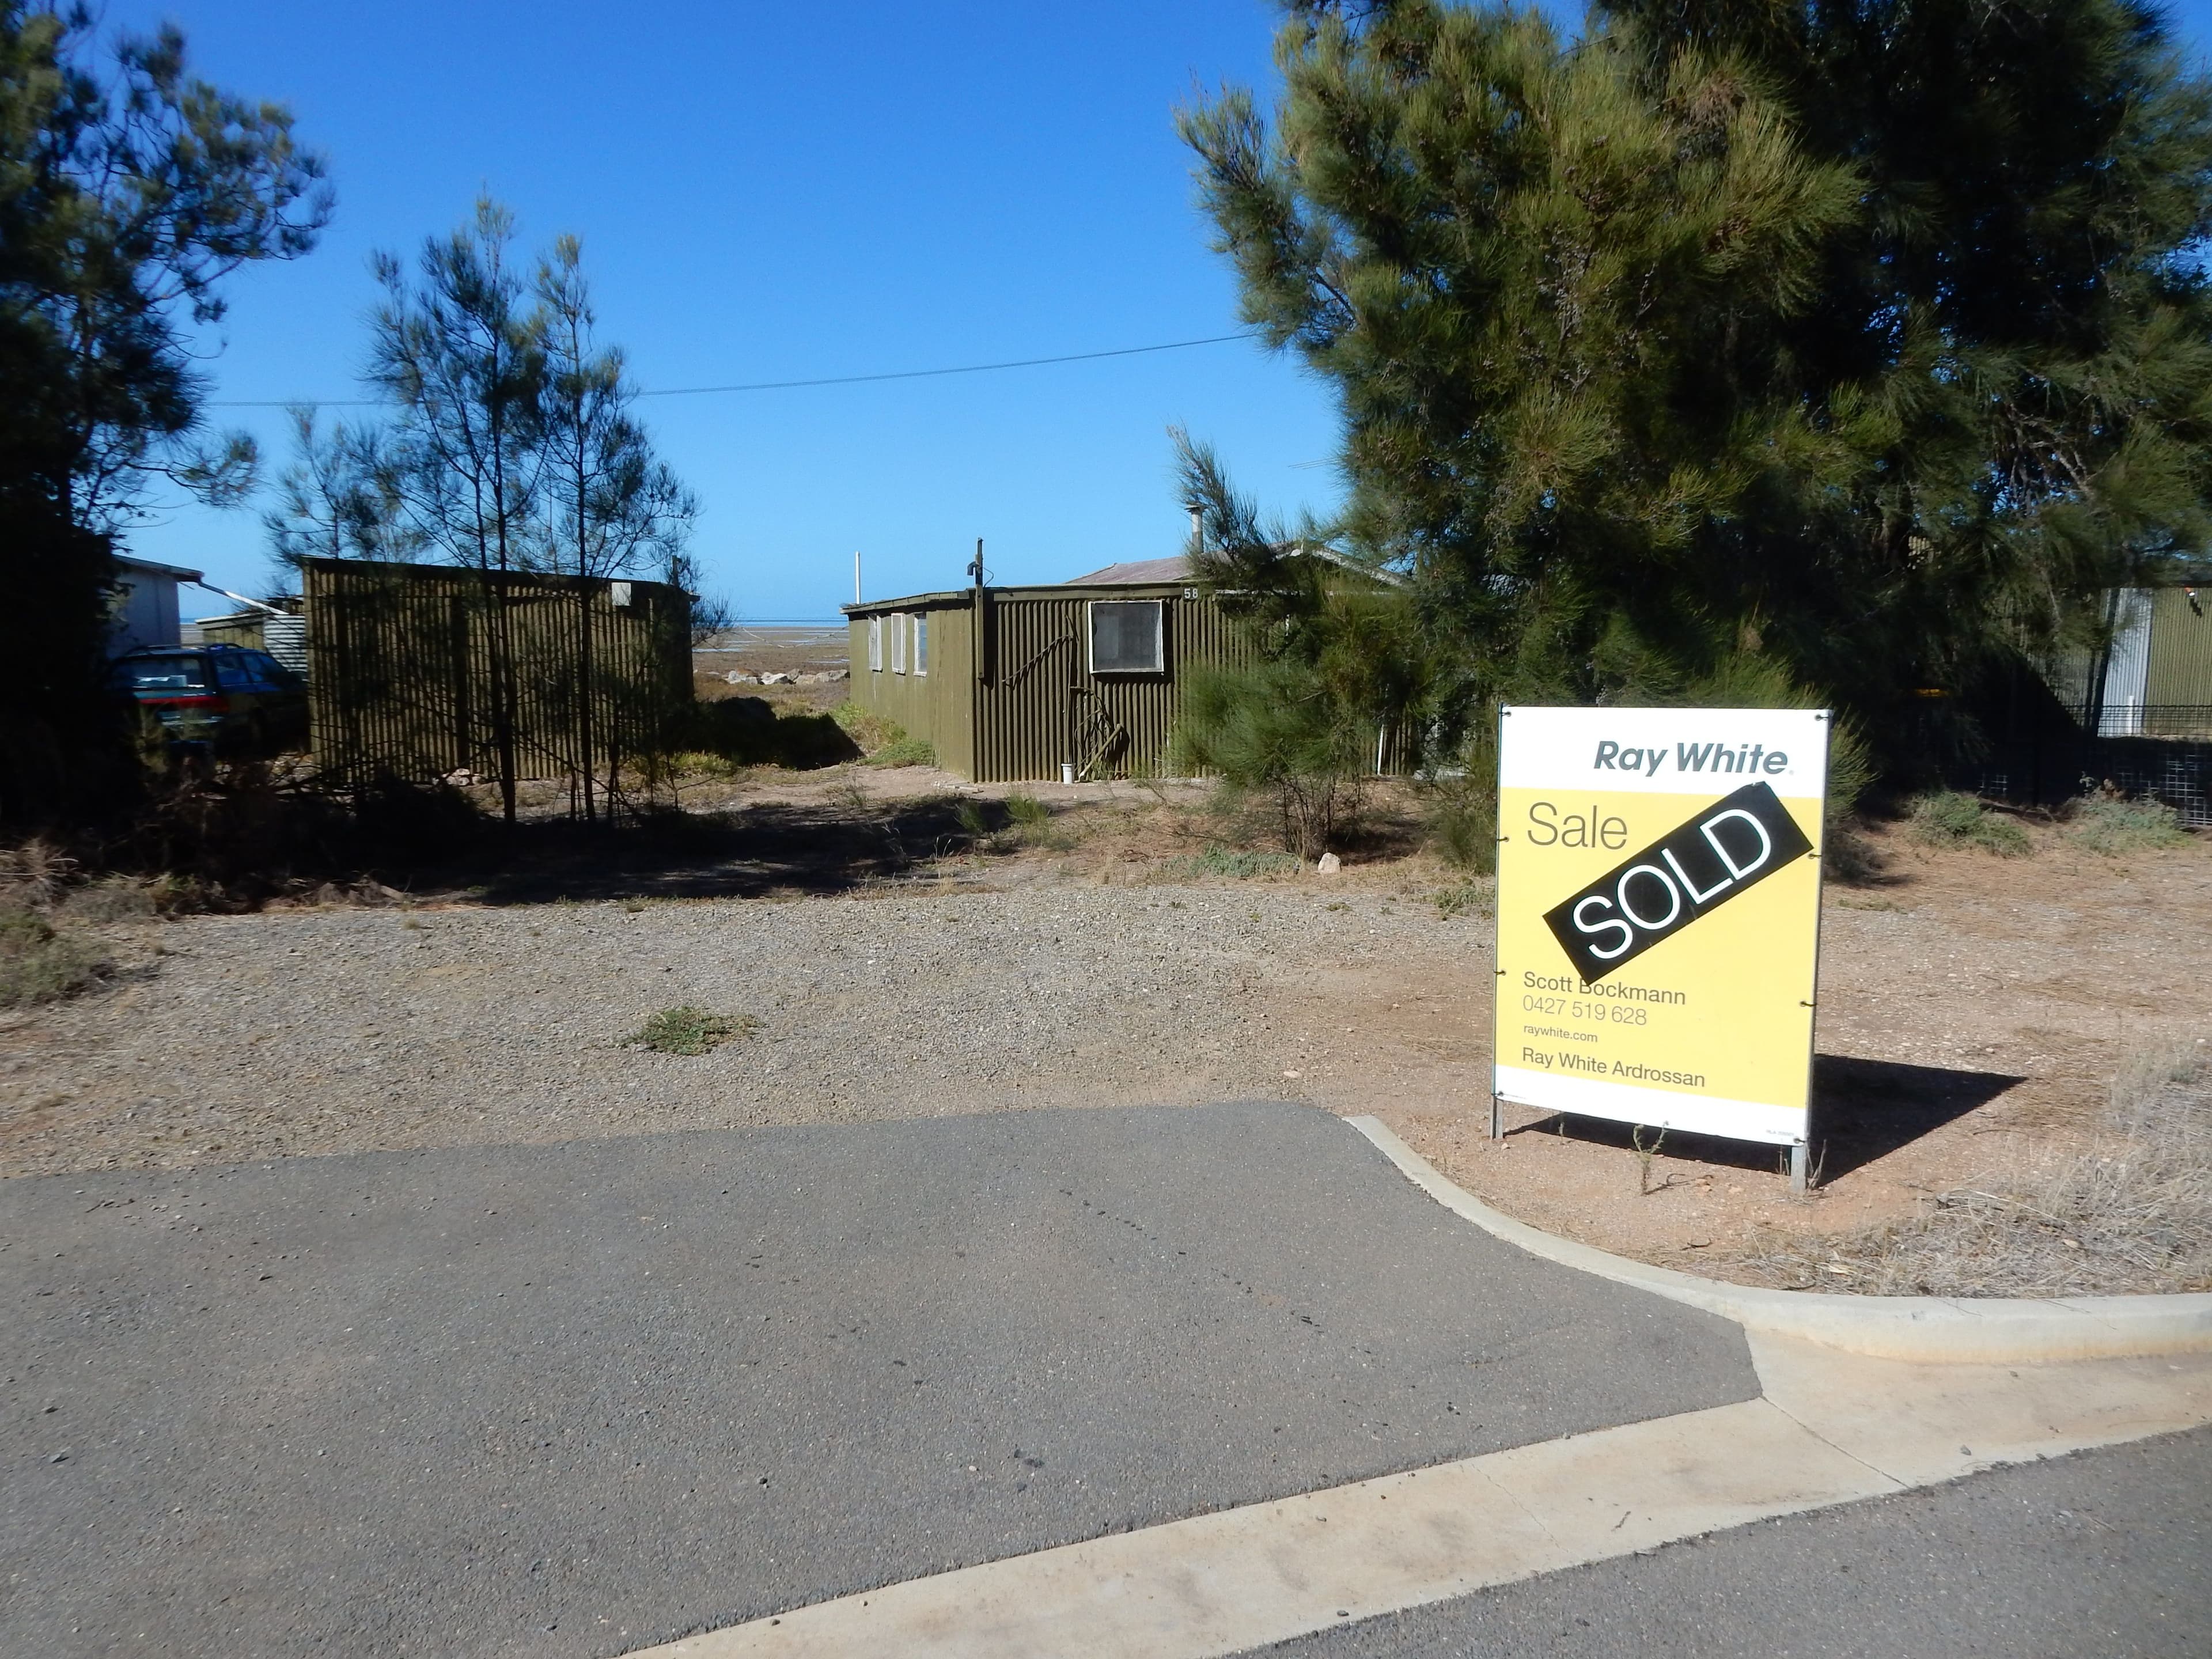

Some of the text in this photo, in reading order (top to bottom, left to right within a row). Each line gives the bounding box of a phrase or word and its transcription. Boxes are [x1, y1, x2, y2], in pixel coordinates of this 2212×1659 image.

[1184, 588, 1198, 599] 58
[1593, 740, 1788, 777] Ray White
[1527, 802, 1627, 850] Sale
[1573, 808, 1771, 960] SOLD
[1523, 971, 1685, 1005] Scott Bockmann
[1522, 995, 1647, 1026] 0427 519 628
[1523, 1025, 1598, 1043] raywhite.com
[1522, 1047, 1705, 1087] Ray White Ardrossan
